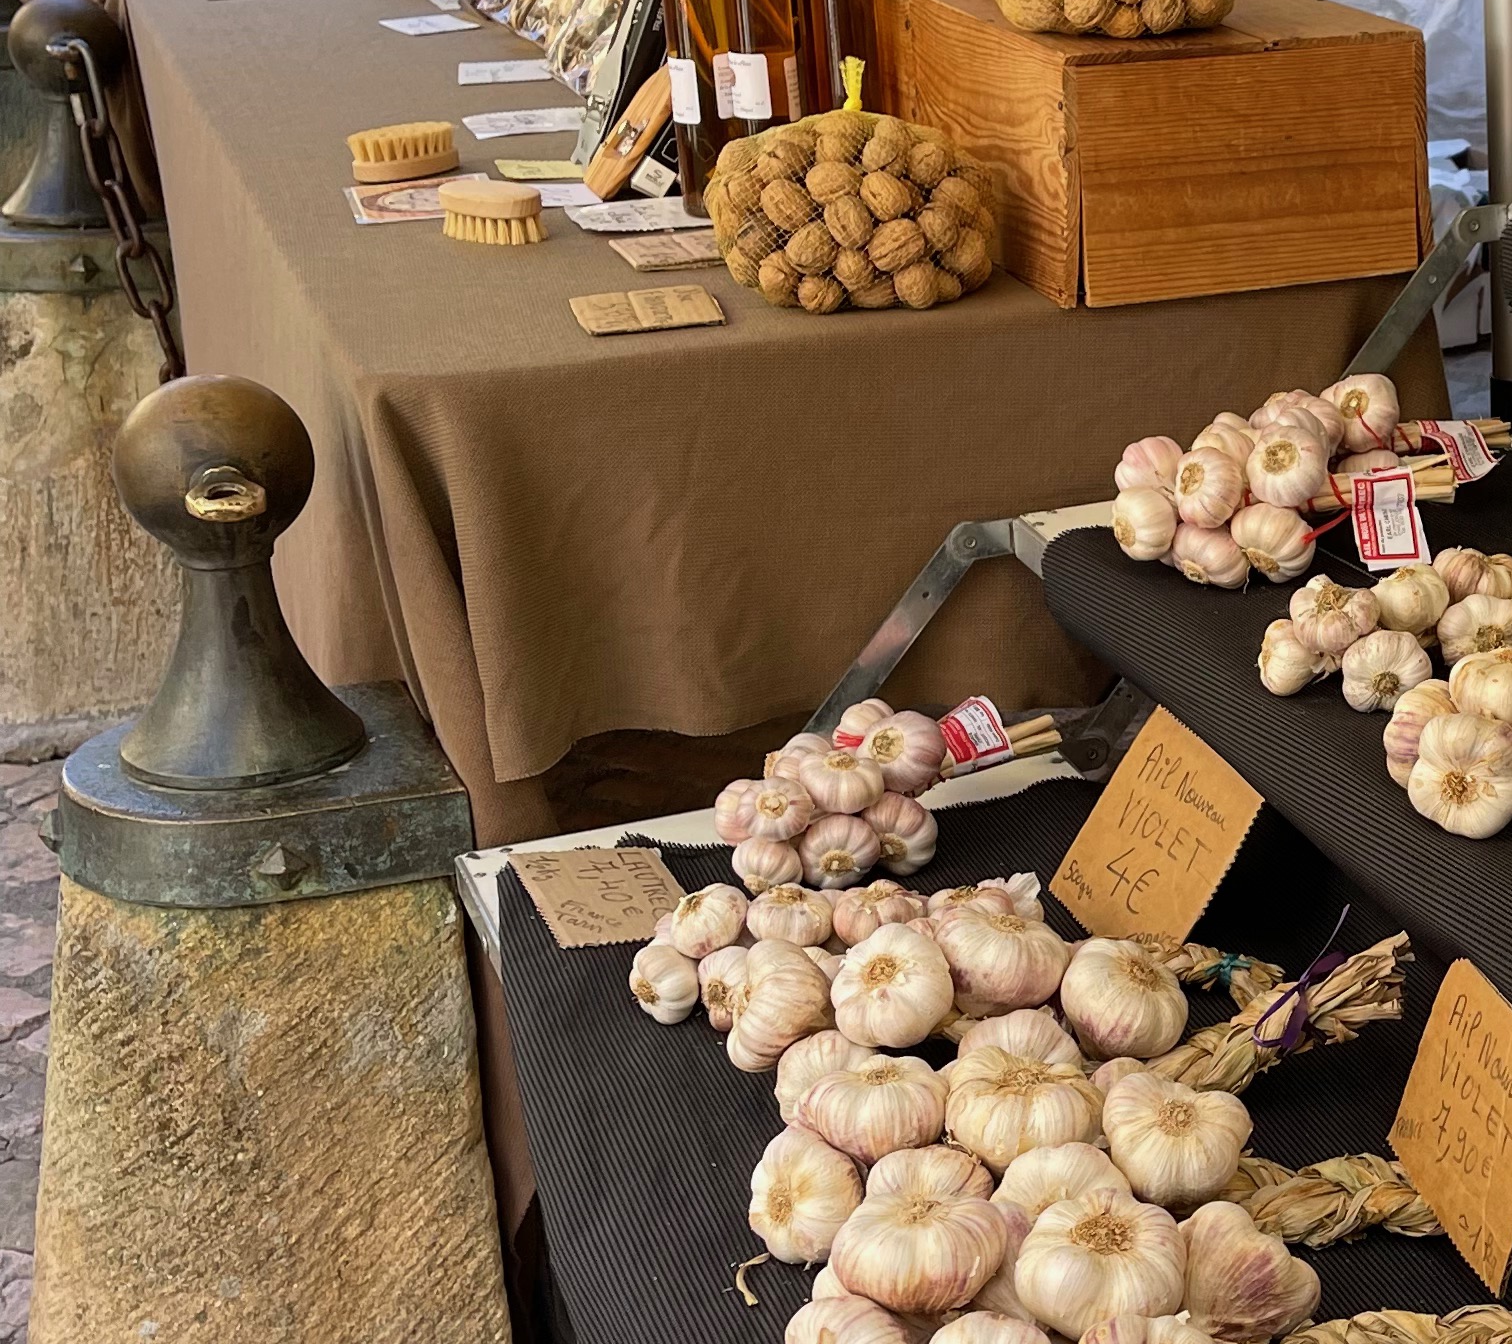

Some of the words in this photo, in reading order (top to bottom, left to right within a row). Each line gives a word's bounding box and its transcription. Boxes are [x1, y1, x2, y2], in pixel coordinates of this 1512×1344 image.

[1137, 742, 1183, 790] Ail
[1174, 769, 1227, 832] Nouveau
[1448, 994, 1483, 1049] Ail
